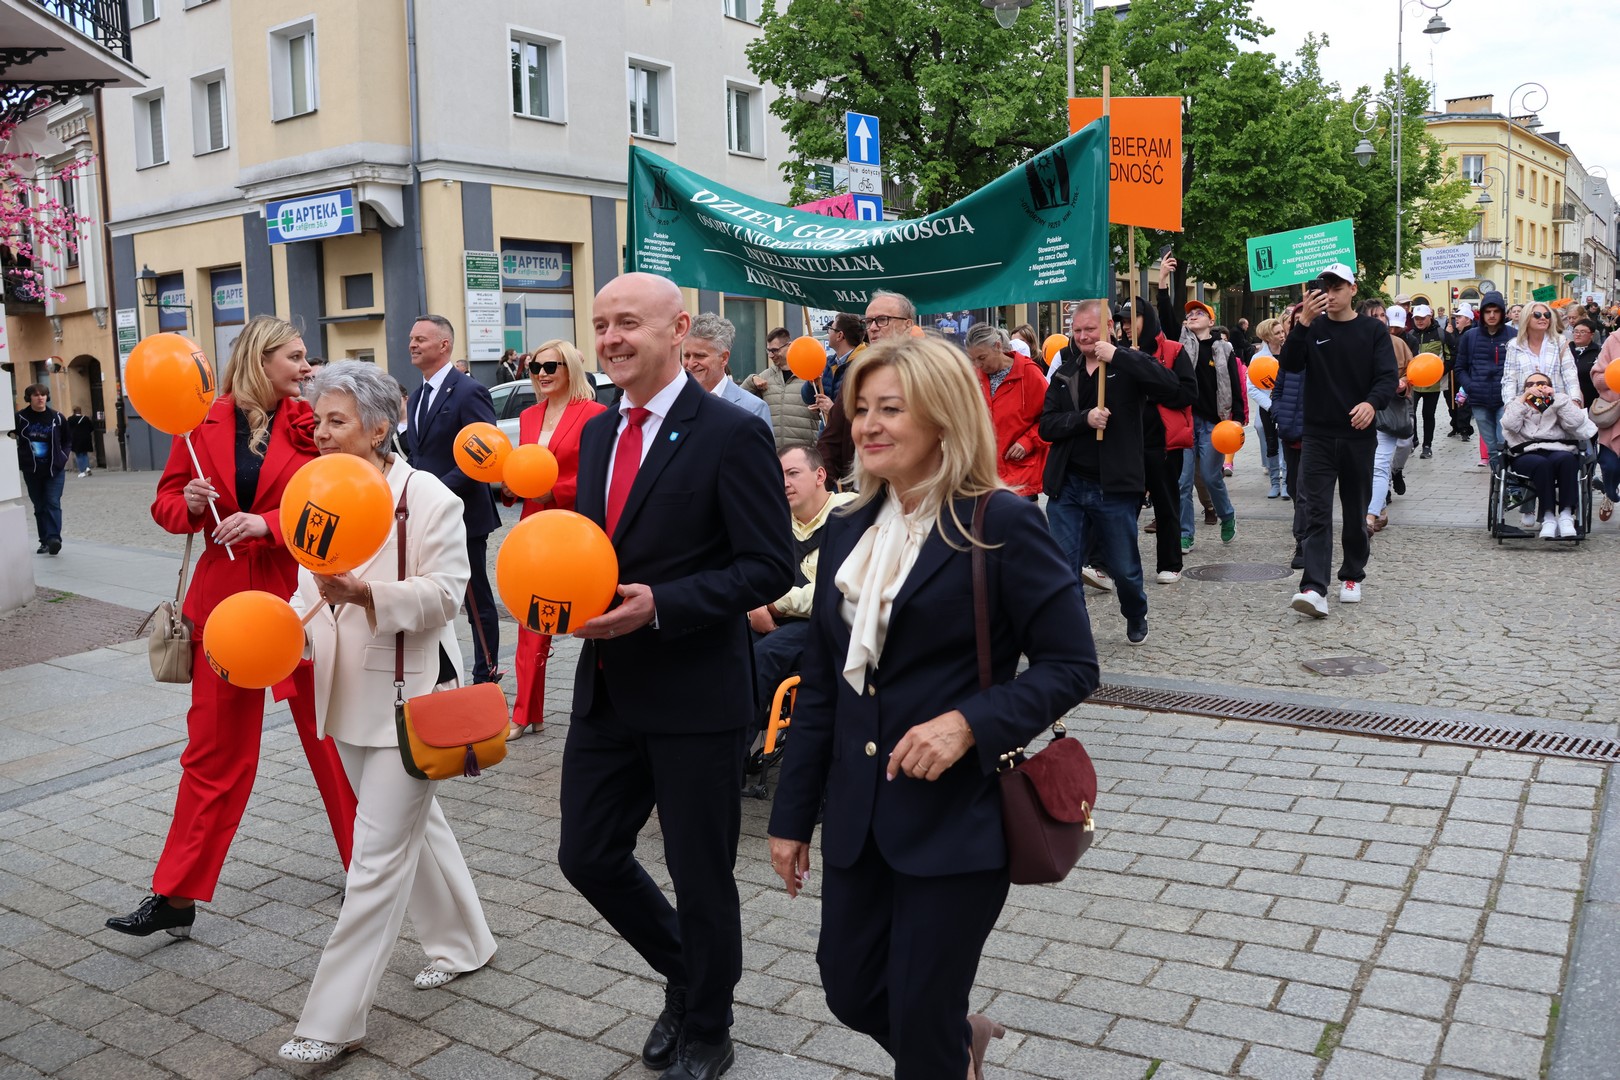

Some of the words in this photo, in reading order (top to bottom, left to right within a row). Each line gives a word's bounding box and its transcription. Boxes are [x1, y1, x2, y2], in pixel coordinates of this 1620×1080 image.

[1110, 136, 1172, 159] BIERAM
[862, 167, 881, 177] dotyczy
[1110, 160, 1164, 185] DNOŚĆ
[296, 202, 338, 223] APTEKA
[690, 188, 798, 233] DZIEŃ
[316, 220, 328, 230] 36,6
[697, 212, 732, 236] OSOBY
[653, 231, 669, 240] Polskie
[1046, 235, 1062, 244] Polskie
[1303, 232, 1325, 240] POLSKIE
[643, 237, 676, 247] Stowarzyszenie
[1292, 236, 1338, 249] STOWARZYSZENIE
[1037, 242, 1070, 254] Stowarzyszenie
[1304, 246, 1321, 254] RZECZ
[1321, 243, 1337, 251] OSÓB
[742, 245, 885, 272] INTELEKTUALNĄ
[1056, 251, 1068, 259] Osób
[1286, 247, 1351, 263] NIEPEŁNOSPRAWNOŚCIĄ
[518, 255, 560, 270] APTEKA
[643, 257, 670, 266] Intelektualną
[1032, 258, 1077, 270] Niepełnosprawnością
[1296, 257, 1339, 269] INTELEKTUALNĄ
[1429, 263, 1471, 271] WYCHOWAWCZY
[1433, 258, 1466, 266] EDUKACYJNO
[653, 264, 672, 272] Kielcach
[1038, 268, 1065, 278] Intelektualną
[1294, 268, 1309, 276] KOŁO
[744, 264, 807, 299] KIELCE
[833, 289, 868, 303] MAJ
[1033, 278, 1044, 286] Koło
[1049, 276, 1067, 285] Kielcach
[226, 287, 243, 299] APTE
